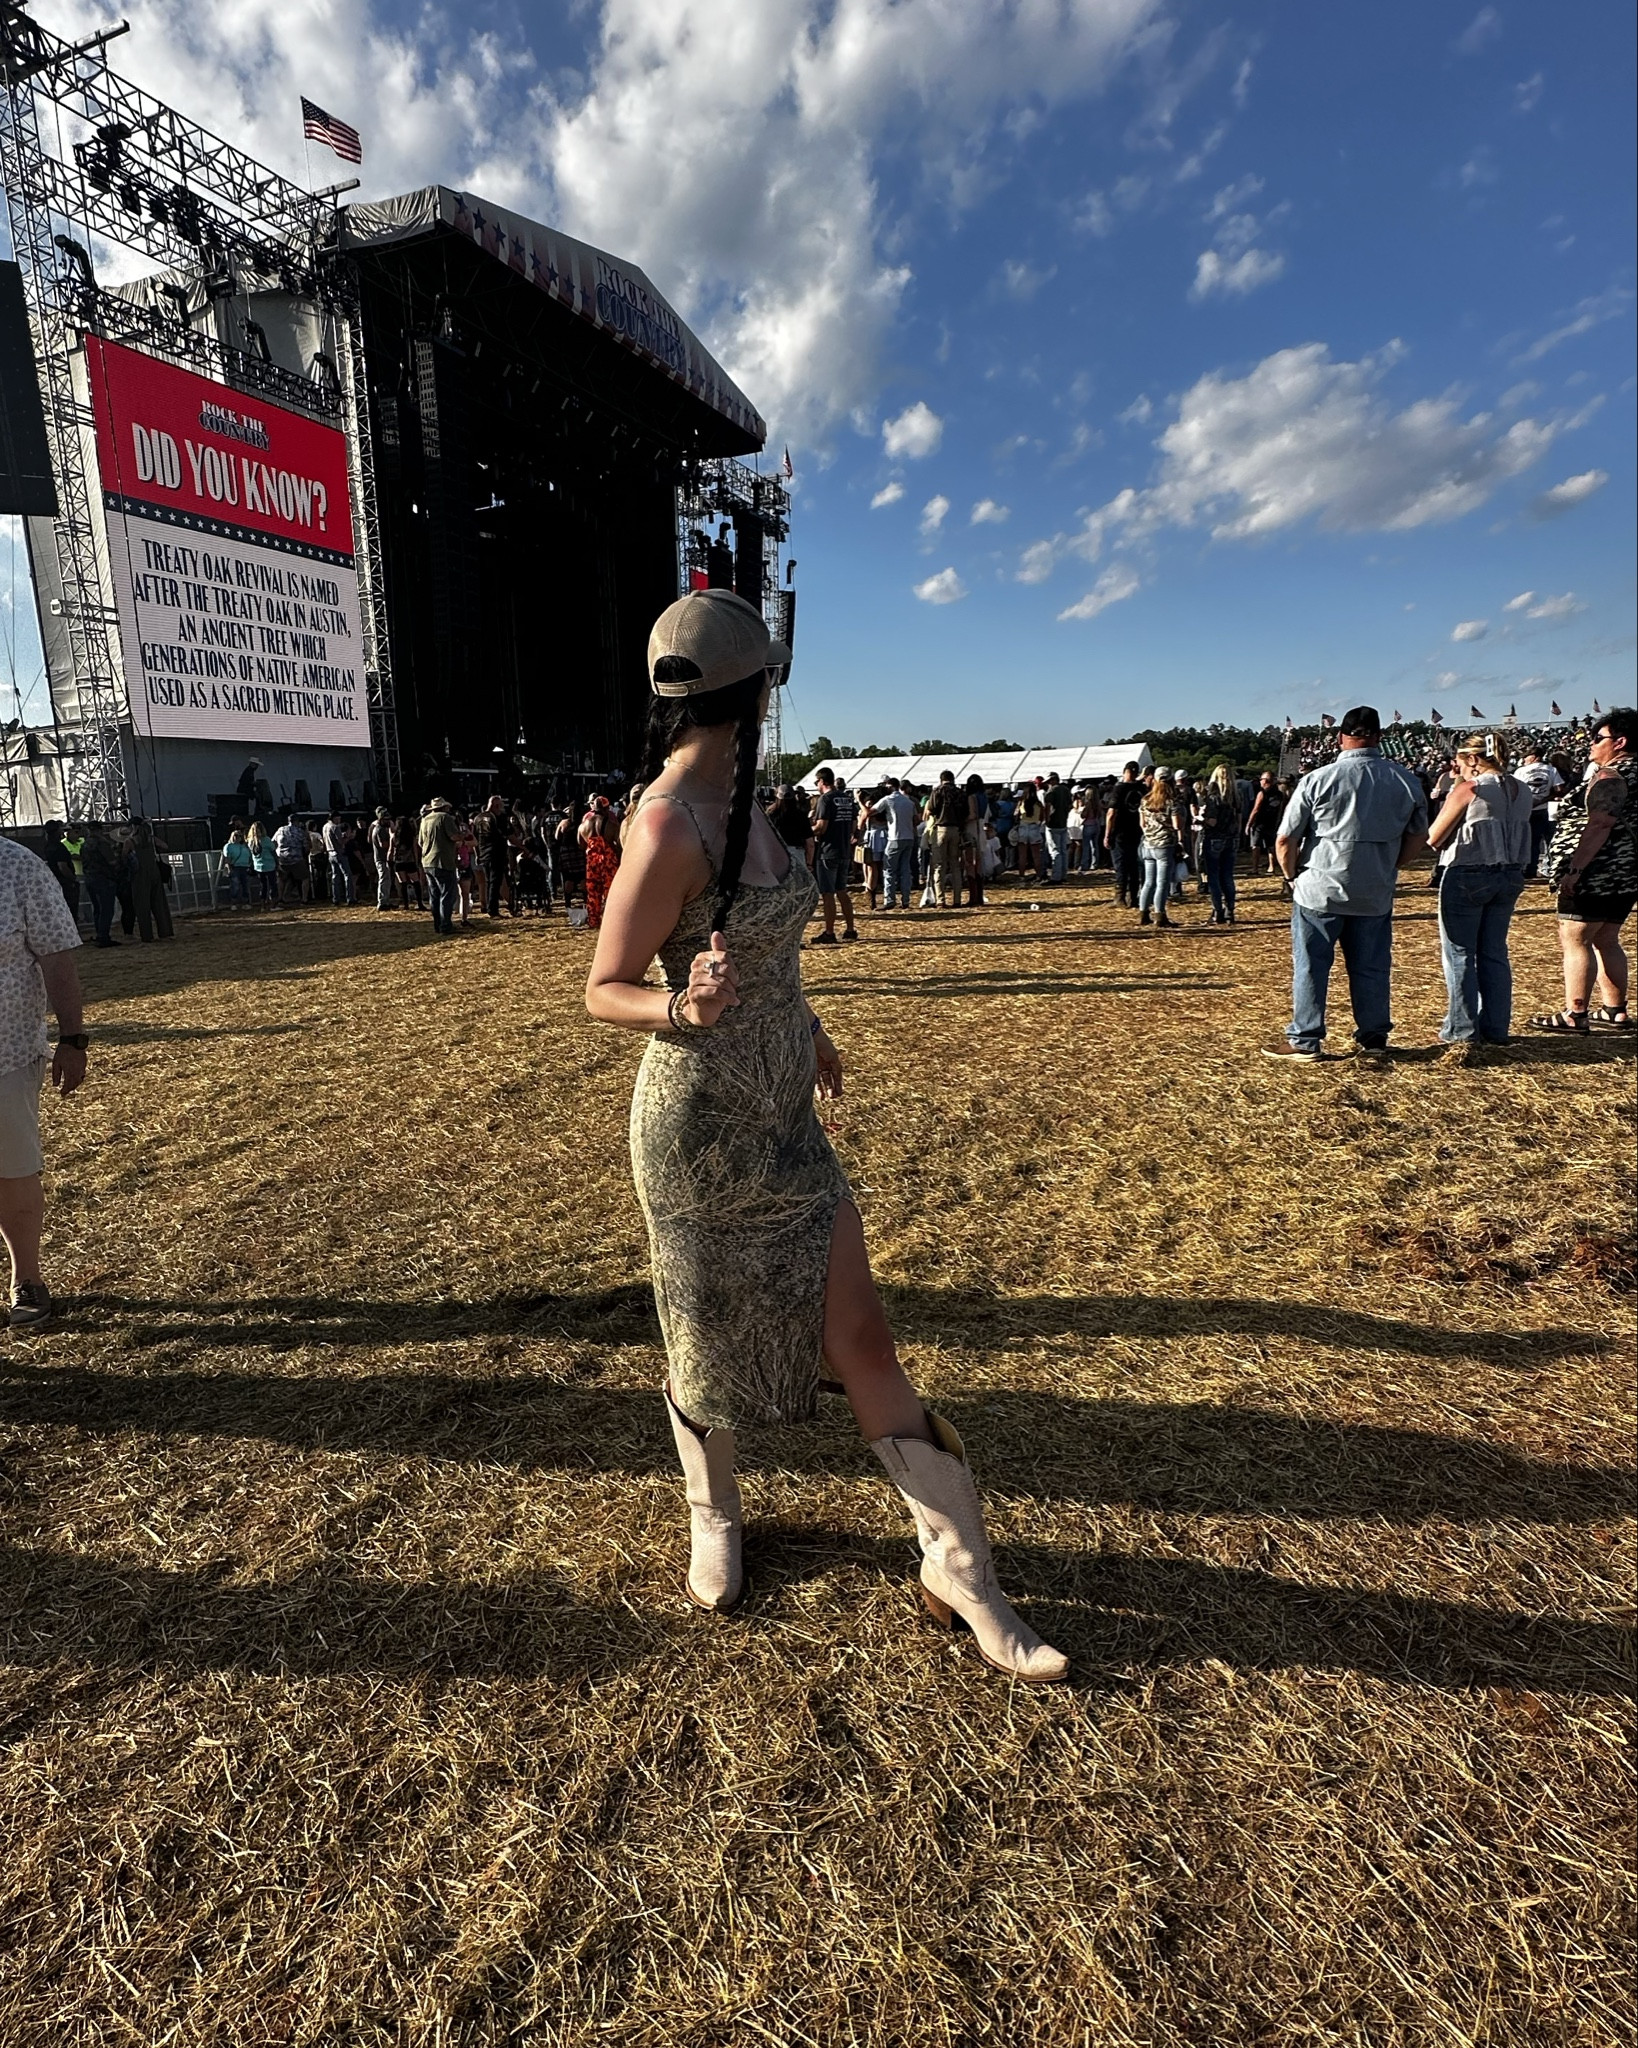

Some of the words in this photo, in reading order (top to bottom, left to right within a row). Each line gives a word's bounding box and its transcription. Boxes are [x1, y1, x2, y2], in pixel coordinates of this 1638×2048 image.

[596, 283, 686, 373] COUNTRY
[597, 257, 649, 315] ROCK
[653, 301, 680, 341] THE
[199, 413, 270, 451] COUNTRY
[202, 400, 236, 423] ROCK
[241, 415, 265, 433] THE
[132, 423, 182, 489] DID
[184, 439, 238, 506] YOU
[242, 458, 327, 531] KNOW?
[142, 539, 198, 578] TREATY
[204, 553, 233, 585] OAK
[235, 560, 286, 596] REVIVAL
[288, 572, 299, 598] IS
[301, 576, 339, 606] NAMED
[134, 572, 181, 608] AFTER
[183, 581, 210, 613] THE
[212, 586, 262, 621] TREATY
[266, 597, 292, 627] OAK
[293, 604, 306, 629] IN
[310, 607, 351, 638] AUSTIN,
[178, 614, 196, 642] AN
[202, 618, 256, 650] ANCIENT
[257, 626, 288, 656] TREE
[289, 633, 327, 661] WHICH
[142, 642, 238, 680] GENERATIONS
[239, 655, 255, 681] OF
[257, 658, 299, 687] NATIVE
[302, 666, 356, 692] AMERICAN
[148, 676, 184, 706] USED
[190, 681, 207, 708] AS
[211, 684, 221, 709] A
[223, 684, 270, 713] SACRED
[273, 689, 323, 717] MEETING
[324, 695, 358, 721] PLACE.
